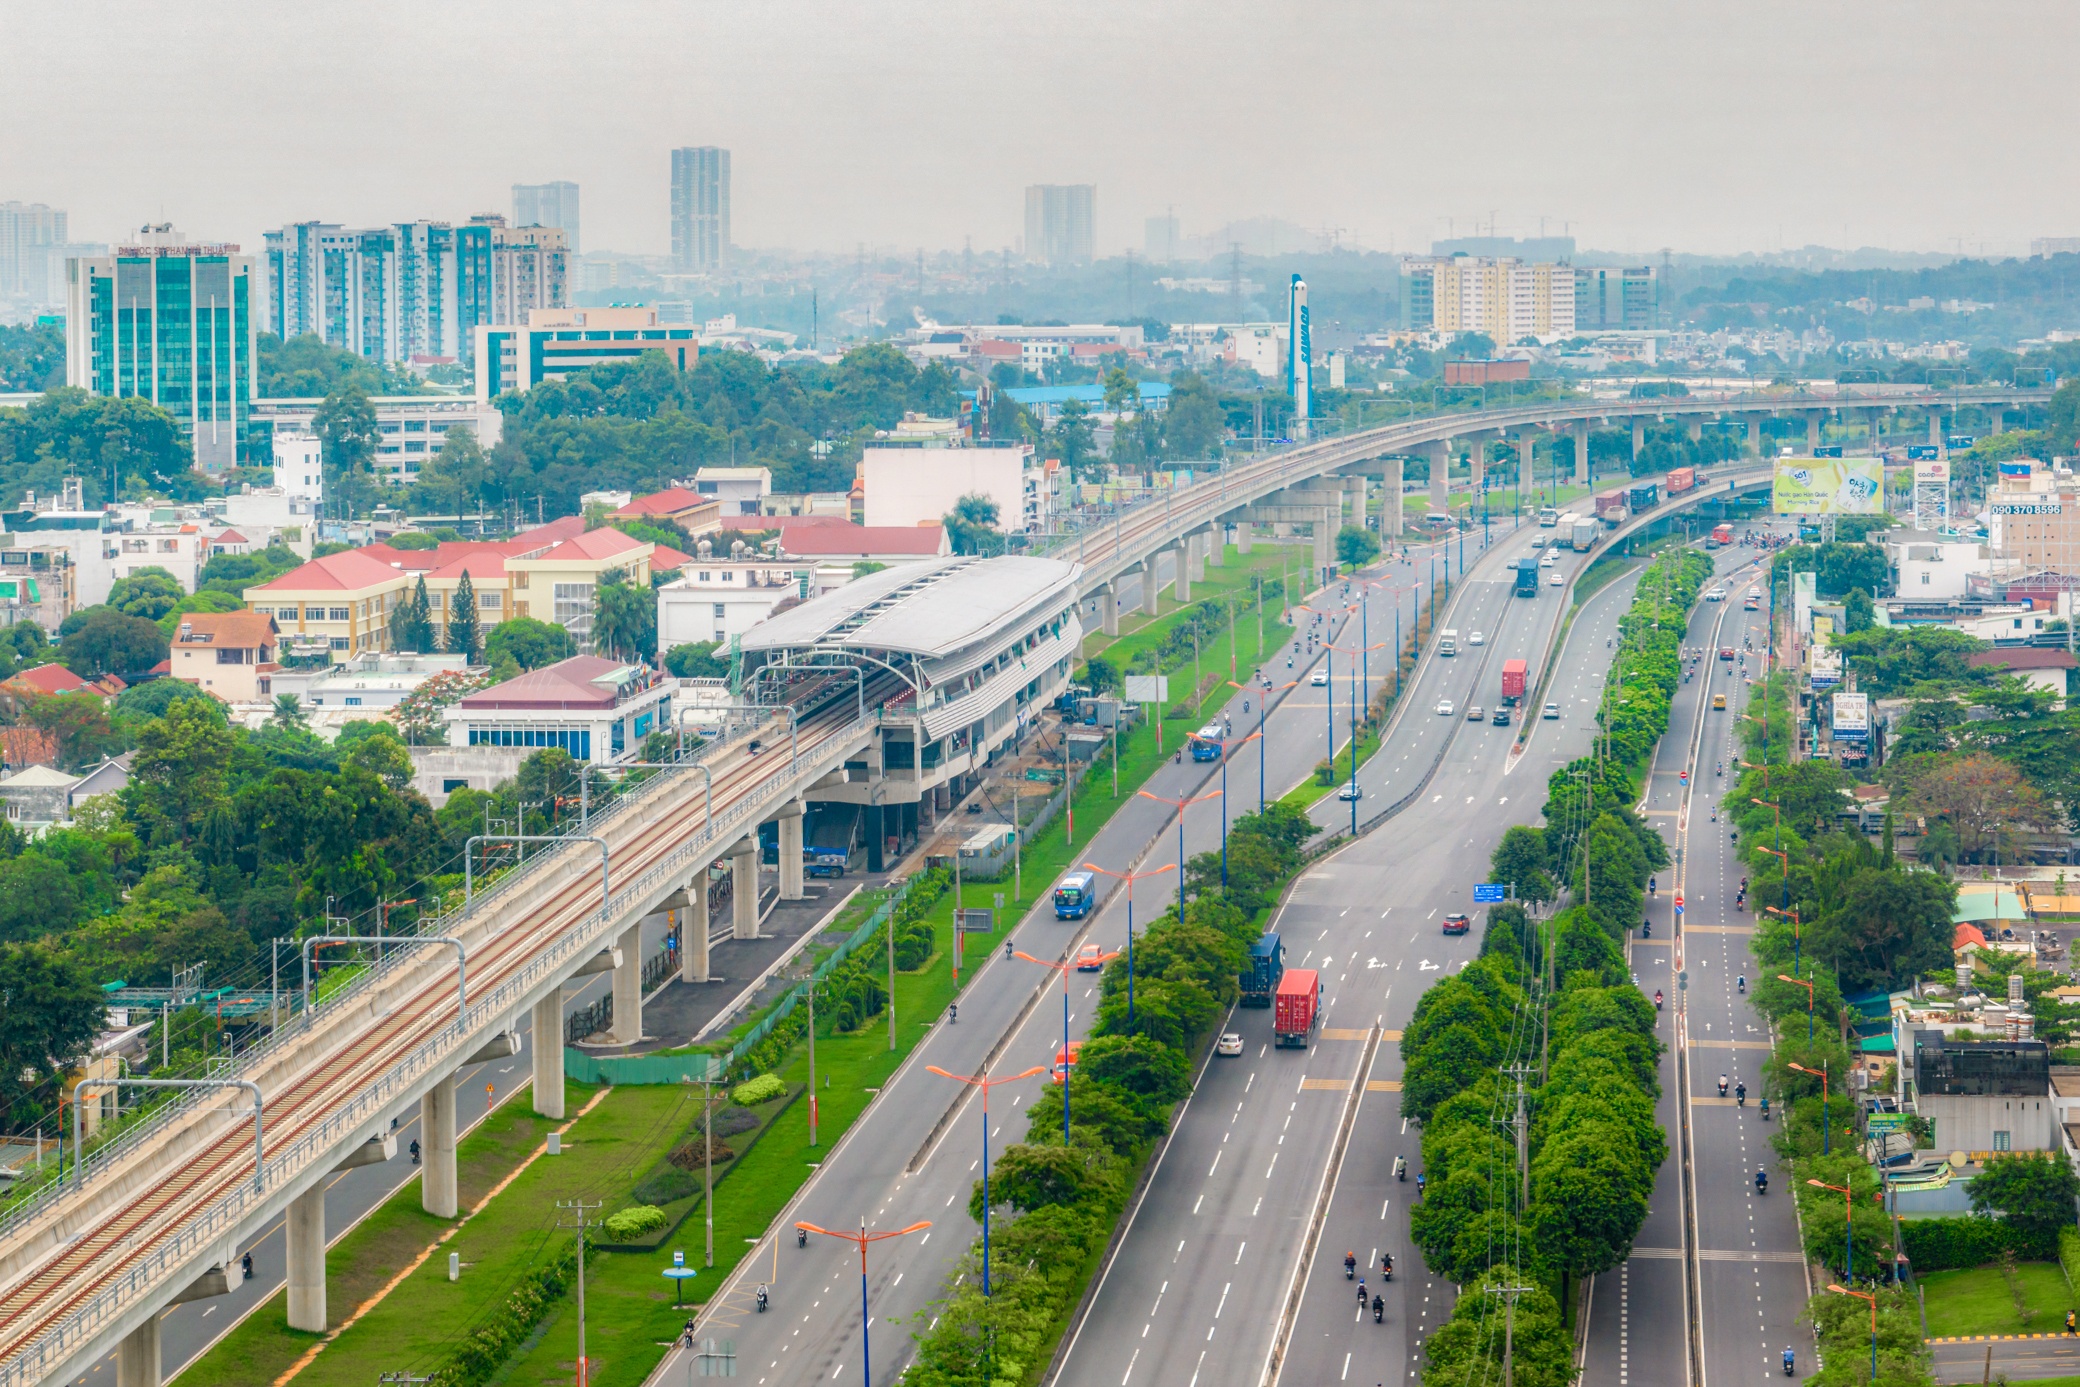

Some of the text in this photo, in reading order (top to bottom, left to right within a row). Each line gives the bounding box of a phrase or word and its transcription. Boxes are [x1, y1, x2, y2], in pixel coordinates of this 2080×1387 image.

[1992, 505, 2060, 514] 090 370 8596
